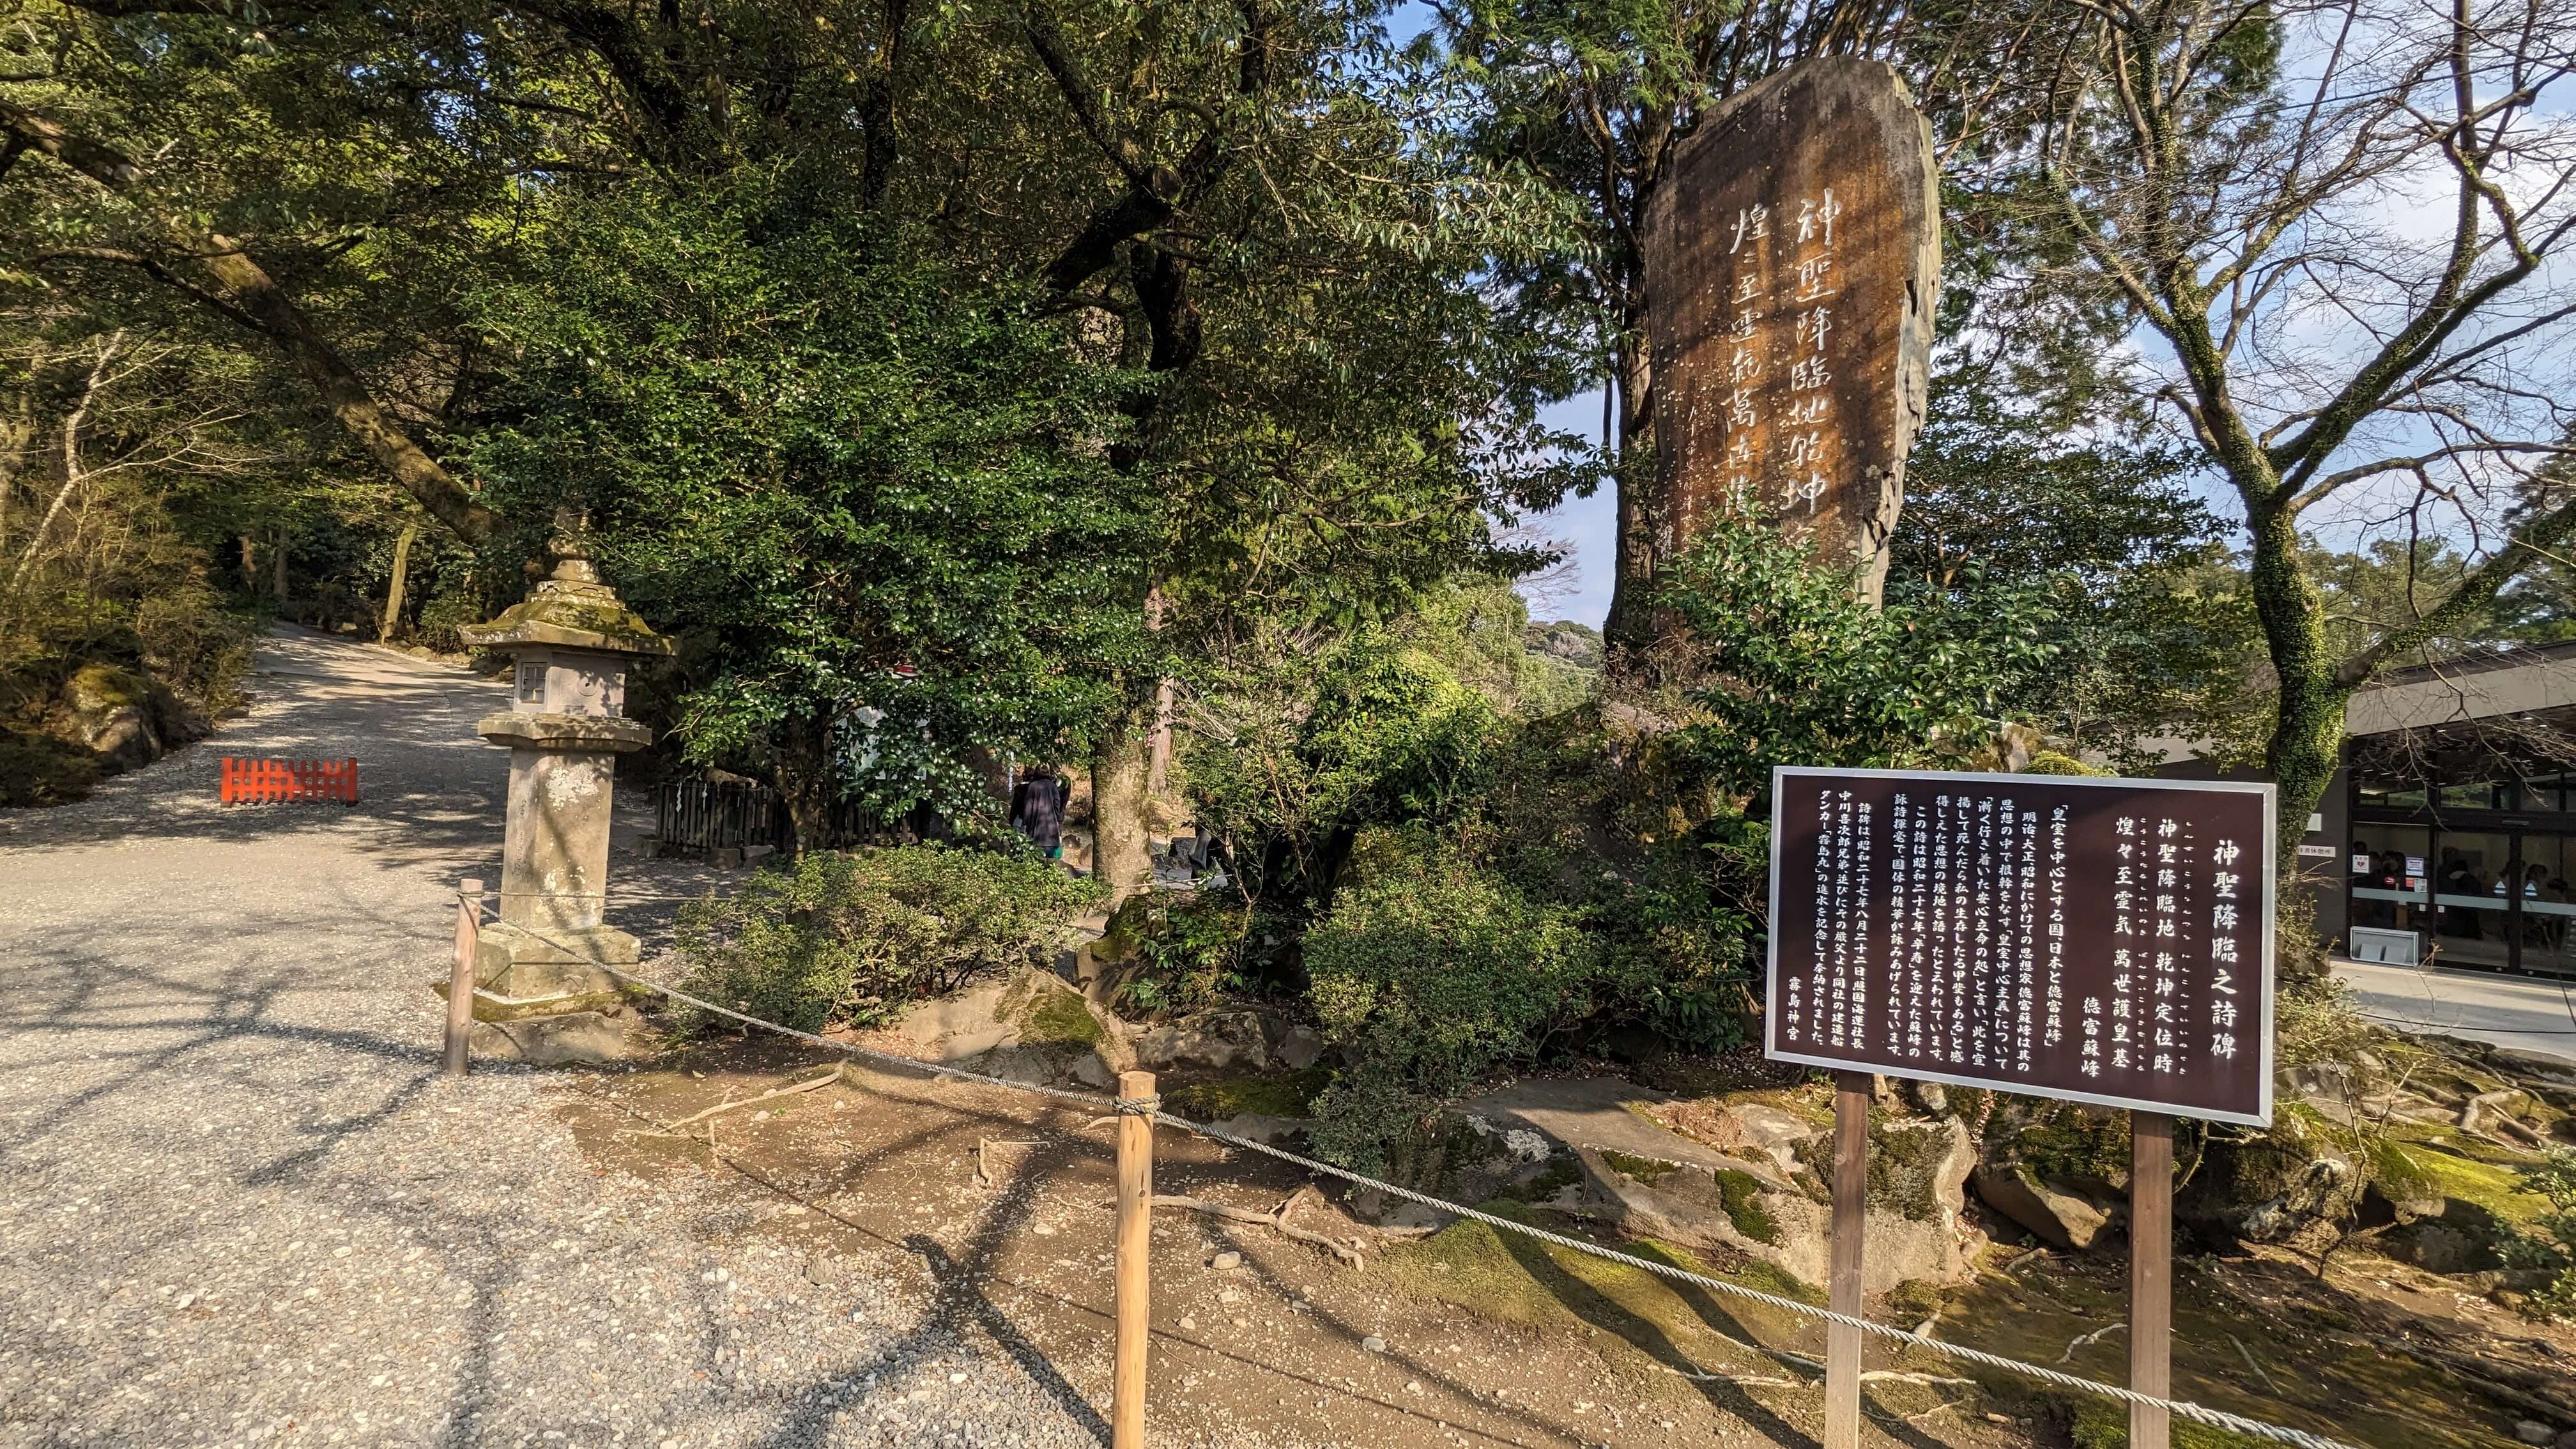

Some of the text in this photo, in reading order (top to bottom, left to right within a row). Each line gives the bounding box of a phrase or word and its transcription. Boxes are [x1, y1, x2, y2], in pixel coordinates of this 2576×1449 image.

[1786, 976, 1802, 1041] 霧島神宮
[2081, 997, 2101, 1078] 徳富蘇峰
[2111, 816, 2135, 1068] 煌々至霊気 萬世護皇基
[2153, 818, 2178, 1073] 神聖降臨地 乾坤定位時
[2210, 839, 2241, 1060] 神聖降臨之詩碑
